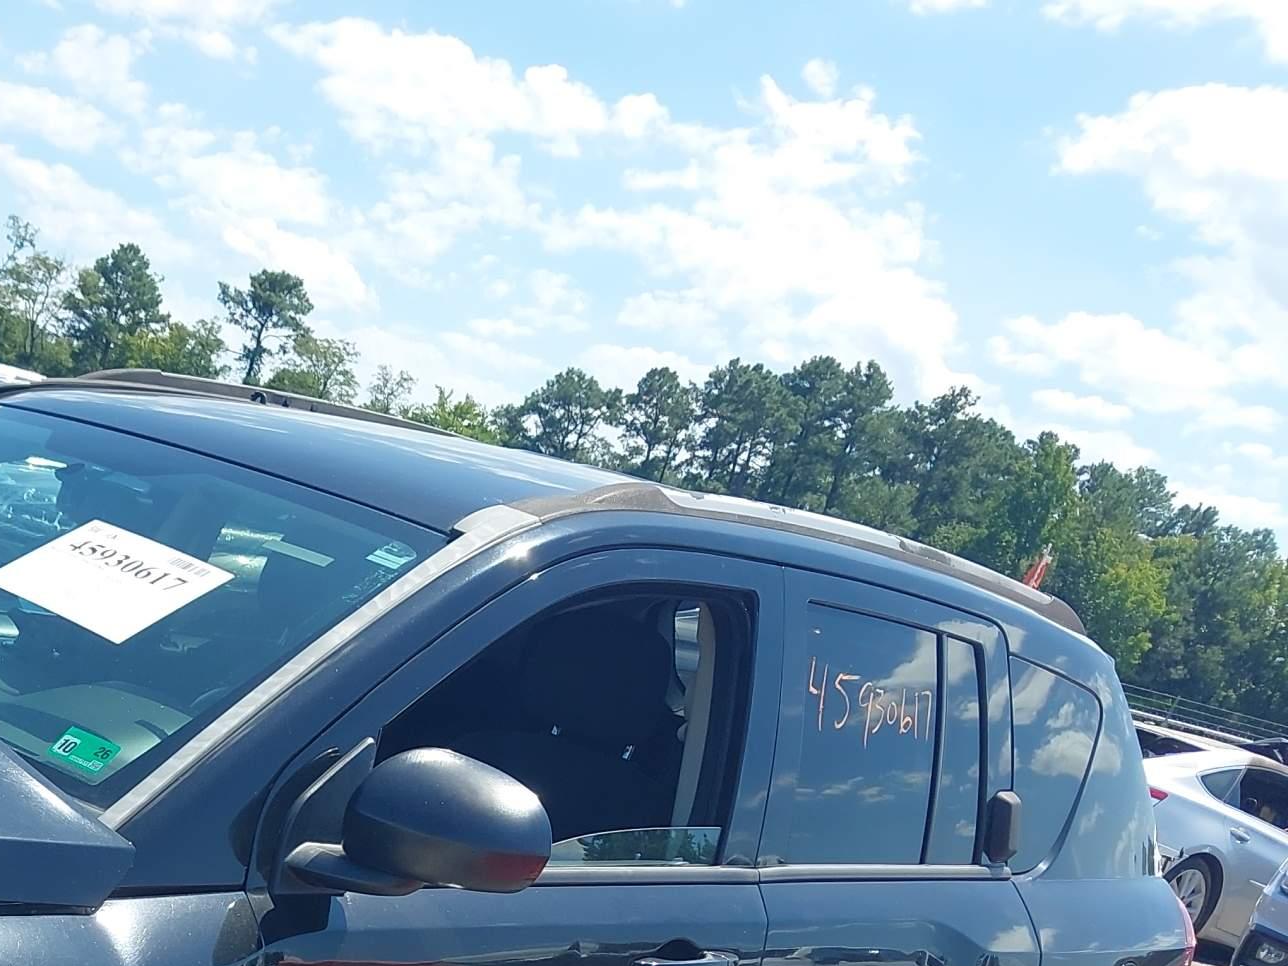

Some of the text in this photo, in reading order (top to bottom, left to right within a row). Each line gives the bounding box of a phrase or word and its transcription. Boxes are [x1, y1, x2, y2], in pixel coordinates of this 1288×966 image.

[69, 540, 189, 591] 45930617
[808, 655, 932, 750] 45930617
[57, 738, 113, 760] 10 26
